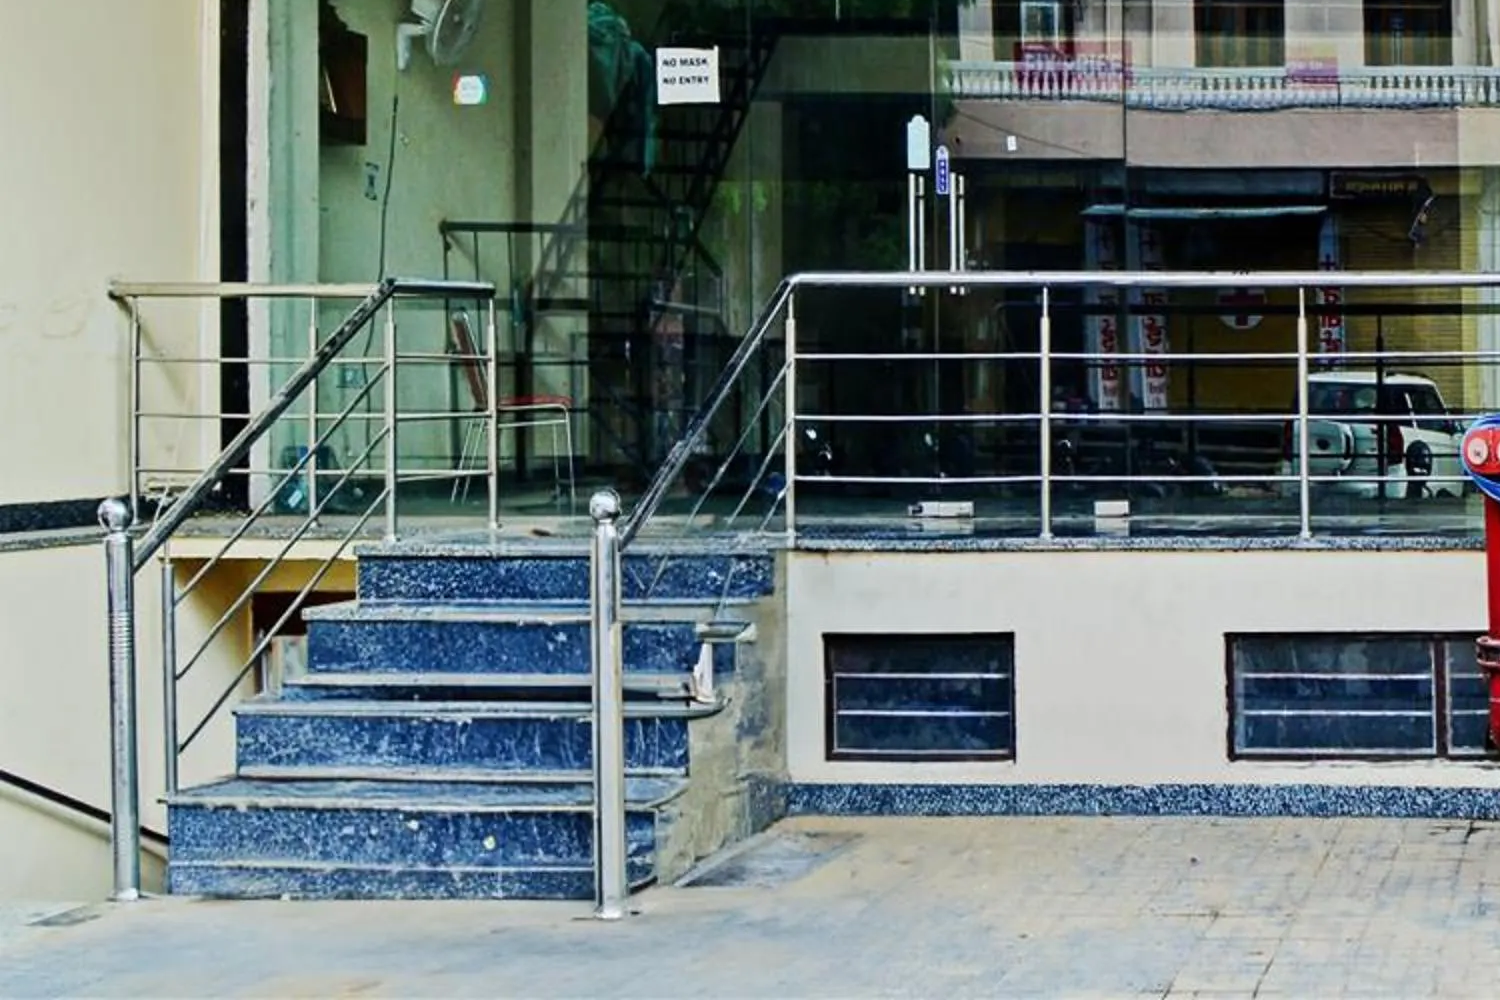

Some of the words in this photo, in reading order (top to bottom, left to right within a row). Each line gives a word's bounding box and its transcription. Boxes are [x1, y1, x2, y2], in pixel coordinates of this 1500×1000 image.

[662, 57, 677, 68] NO
[679, 57, 707, 67] MASK
[662, 76, 677, 85] NO
[679, 75, 708, 85] ENTRY
